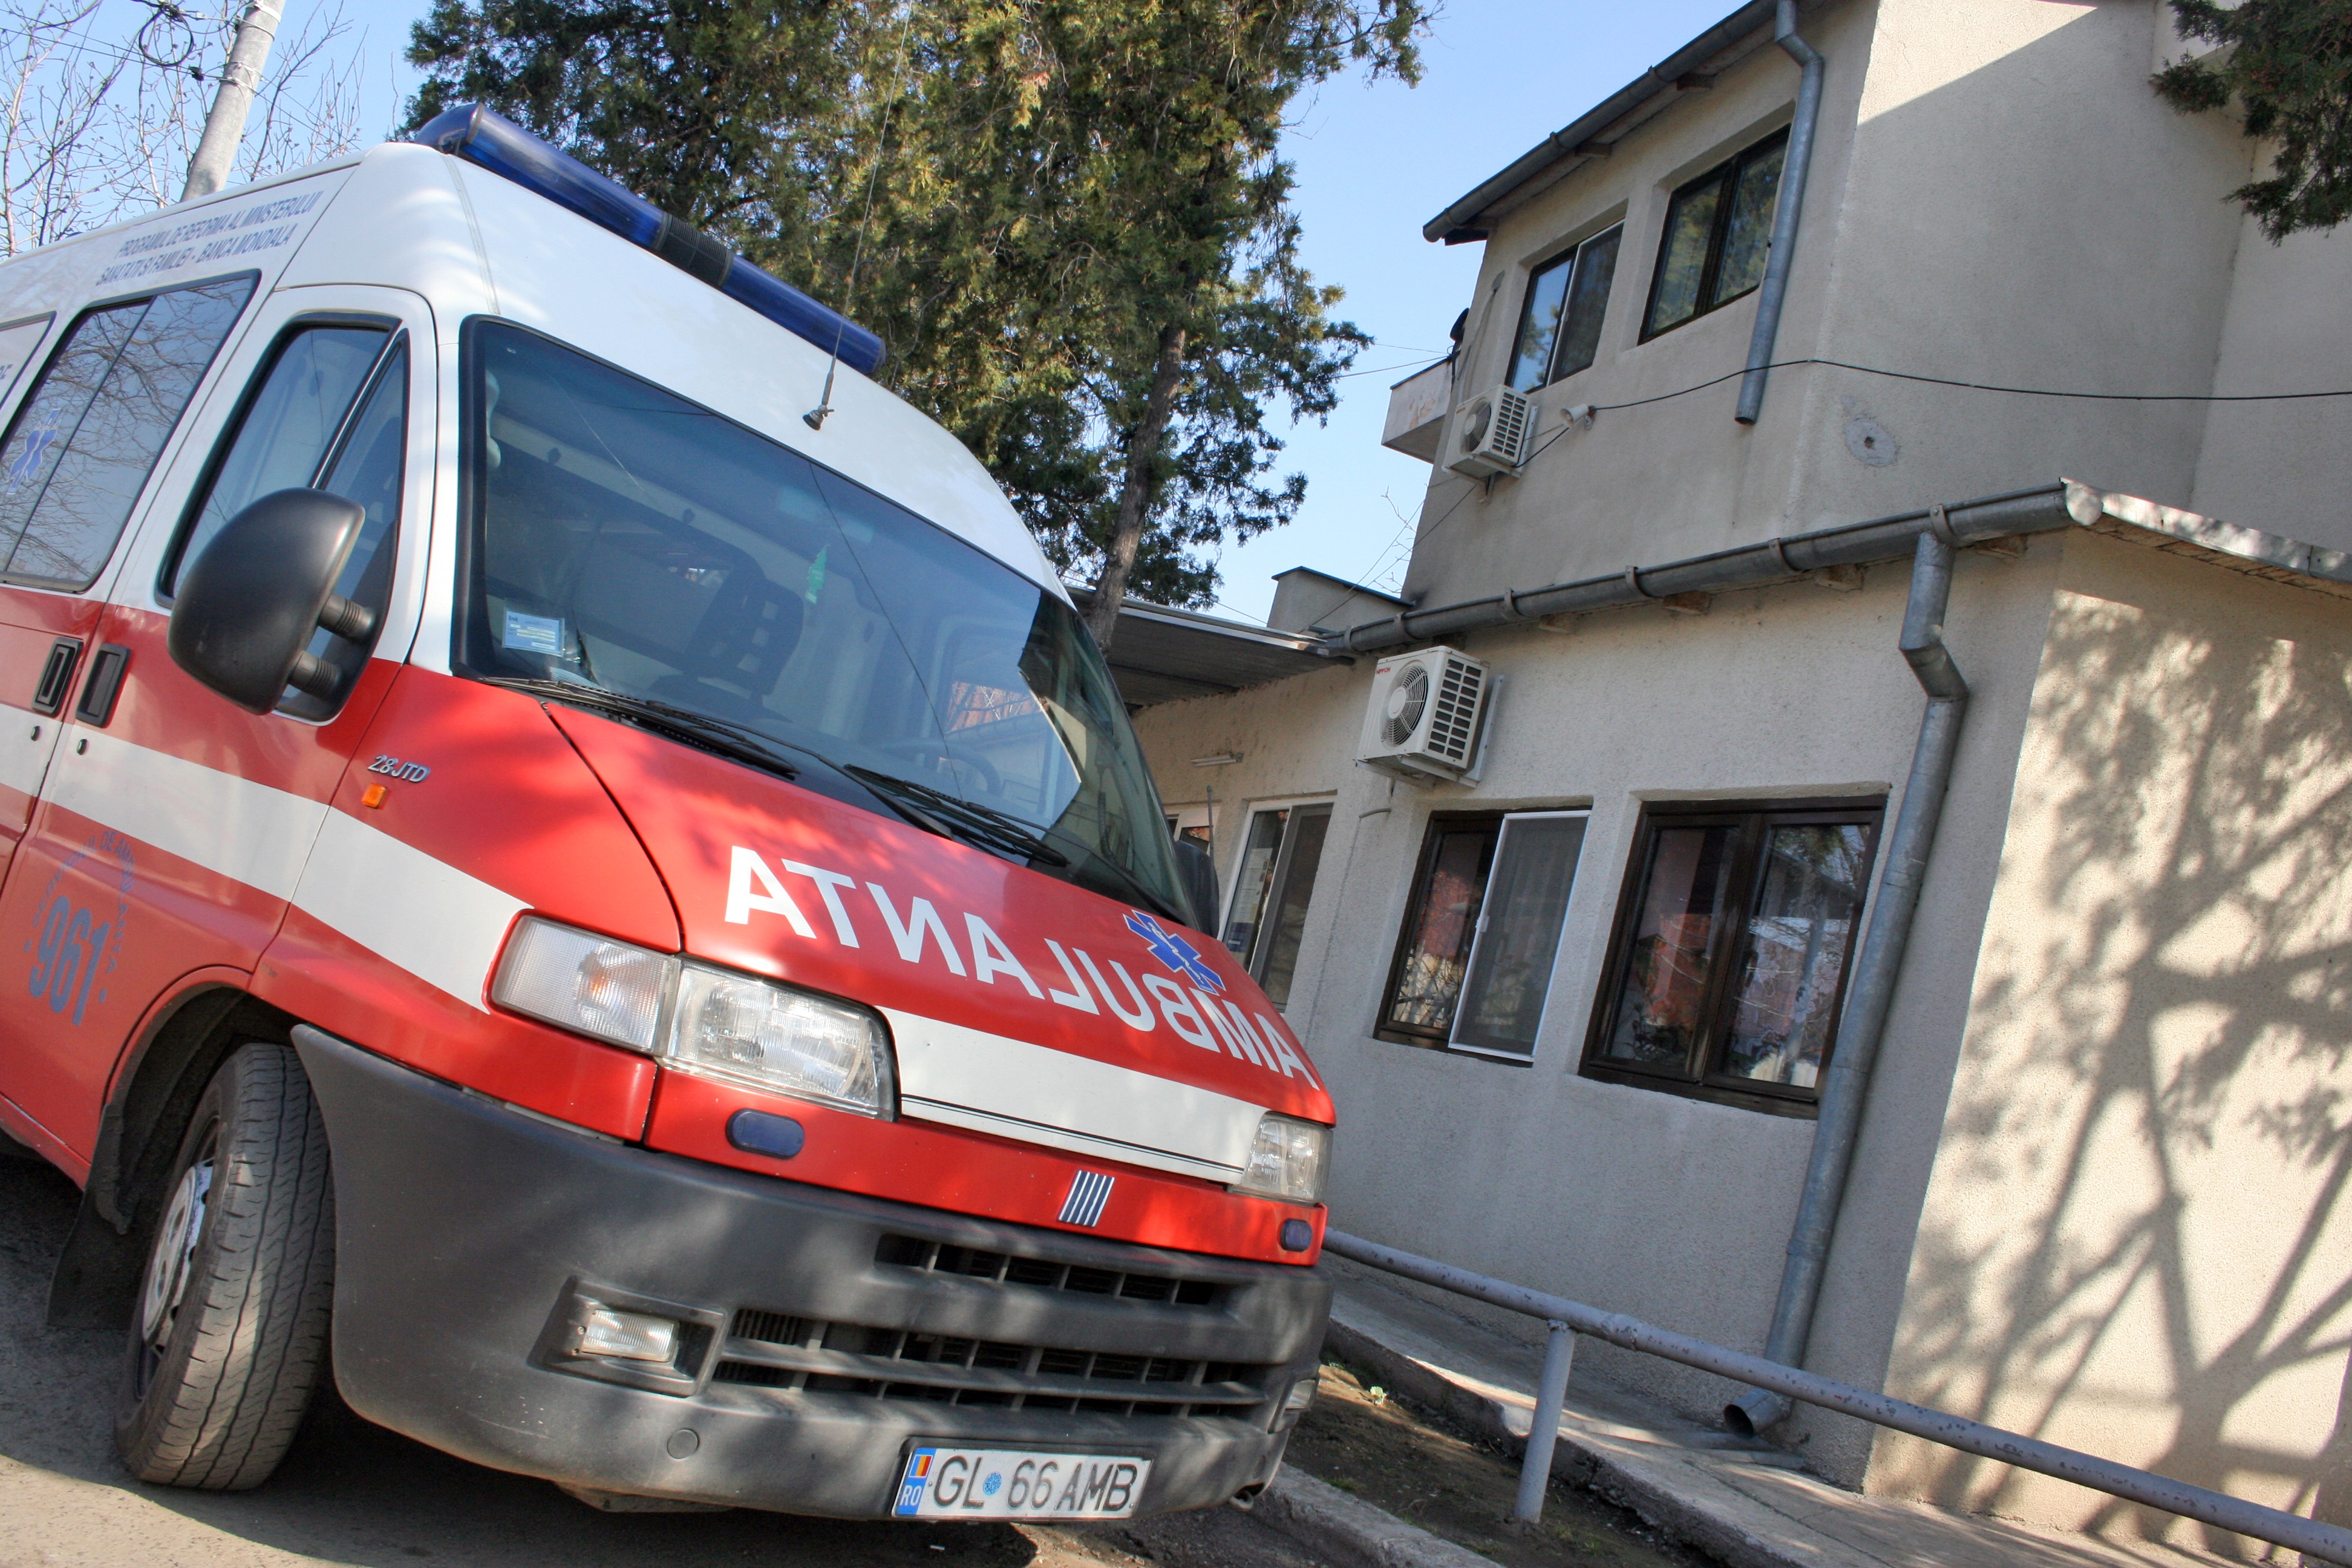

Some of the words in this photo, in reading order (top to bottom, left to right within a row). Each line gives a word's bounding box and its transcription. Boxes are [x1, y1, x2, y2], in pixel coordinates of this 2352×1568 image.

[114, 229, 172, 260] PROGRAMUL
[166, 226, 188, 247] DE
[179, 213, 232, 243] REFORMA
[224, 210, 246, 232] AL
[239, 191, 324, 228] MINISTERULUI
[195, 237, 240, 263] BANCA
[232, 223, 299, 256] MONDIALA
[99, 830, 118, 852] DE
[28, 895, 111, 1027] 961
[900, 1485, 923, 1506] RO
[933, 1454, 985, 1509] GL
[1007, 1458, 1060, 1510] 66
[1054, 1462, 1138, 1512] AMB
